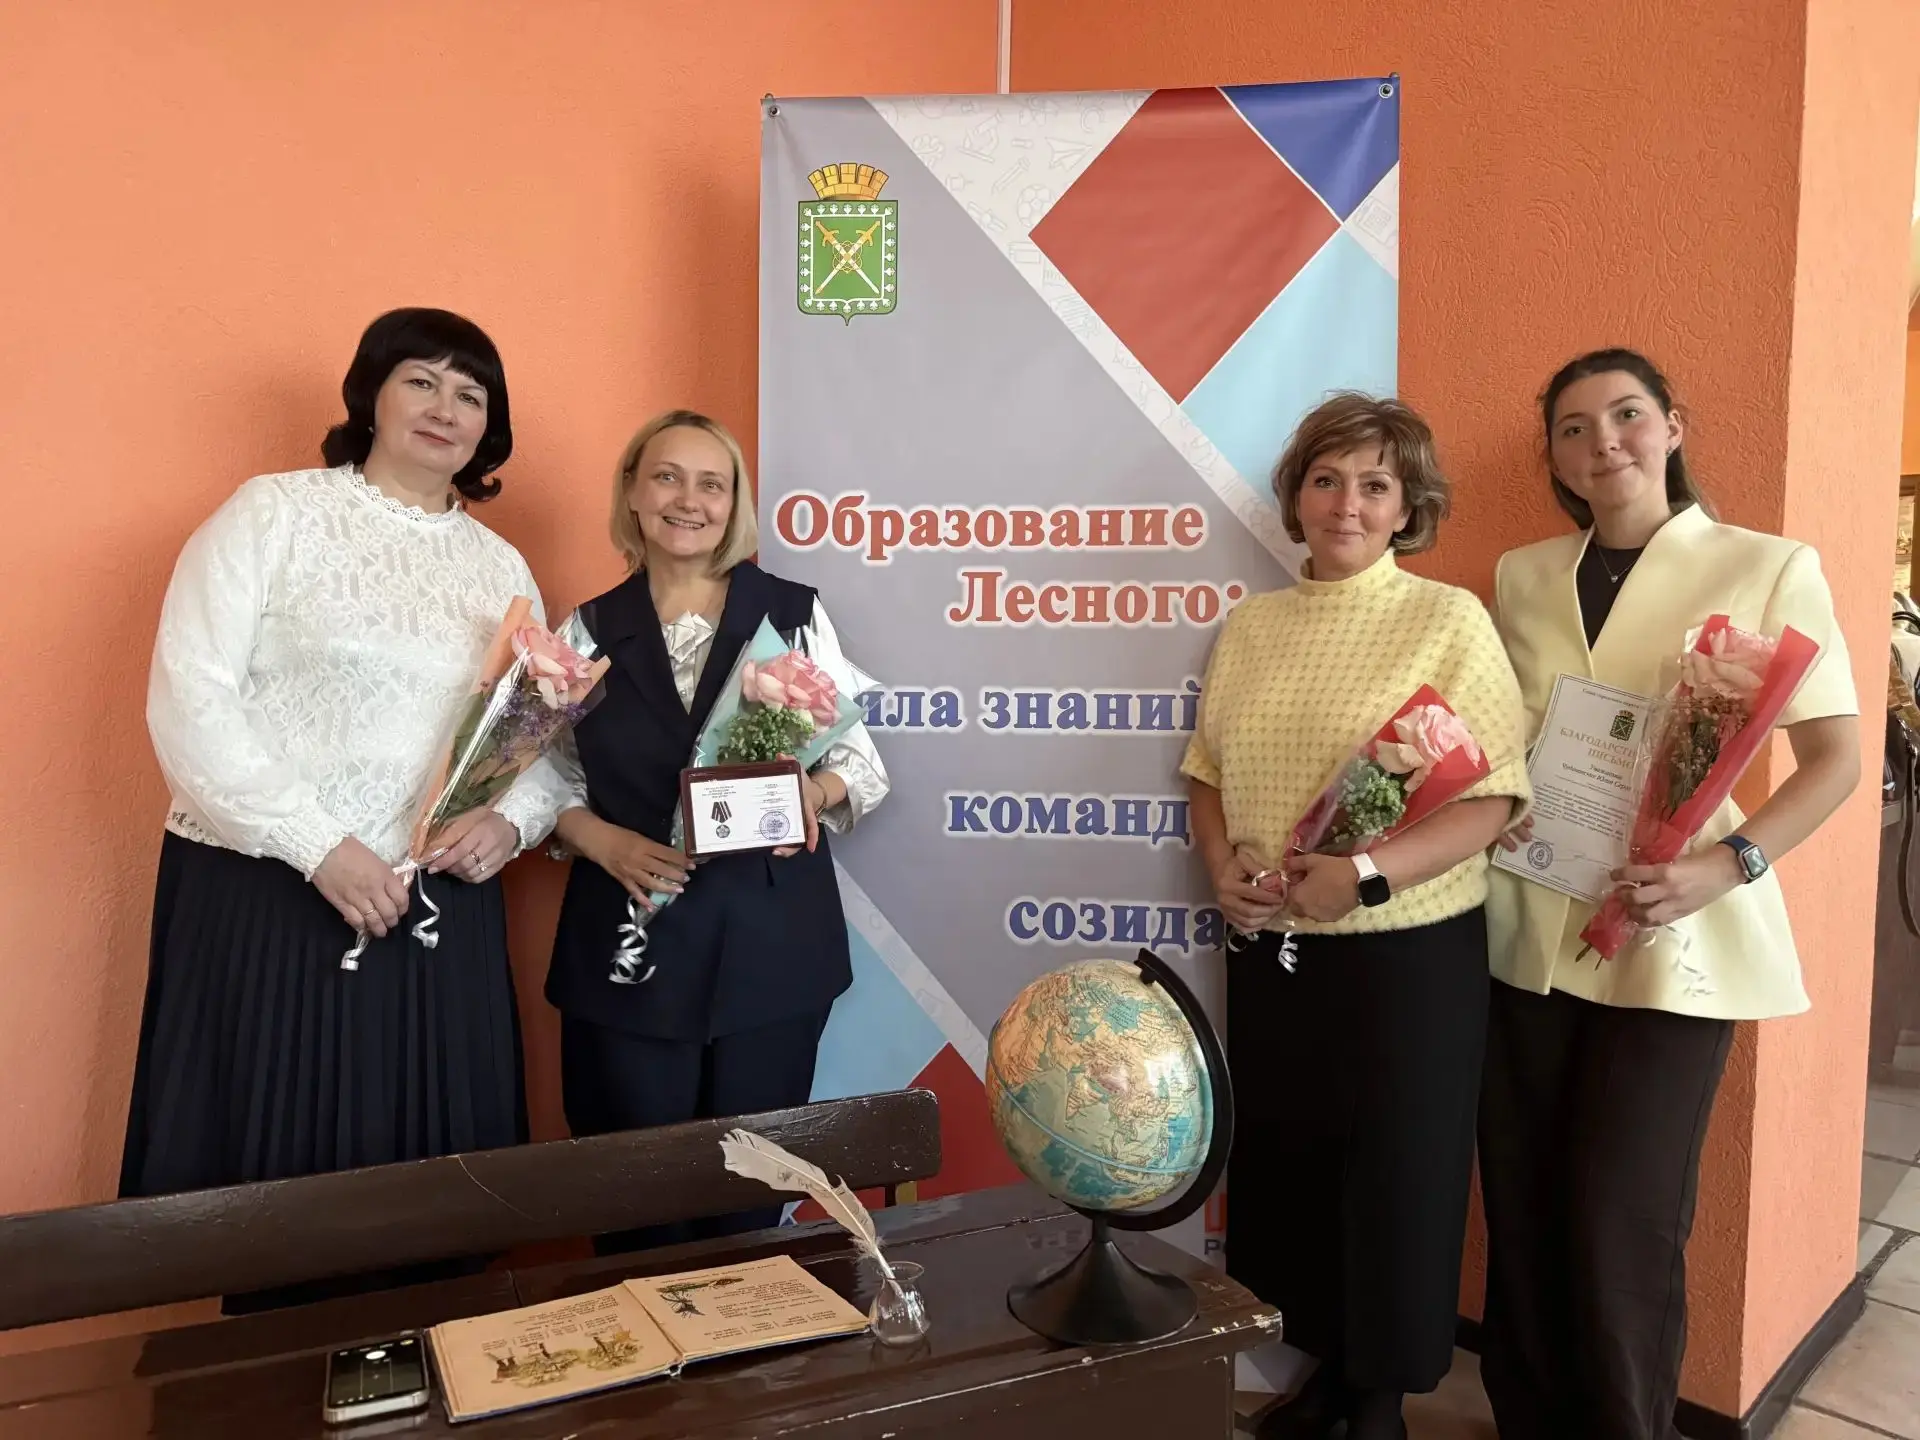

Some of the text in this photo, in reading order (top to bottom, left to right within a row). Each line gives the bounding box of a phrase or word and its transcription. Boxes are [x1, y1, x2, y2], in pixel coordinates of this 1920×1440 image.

[776, 495, 1204, 561] Образование
[854, 690, 963, 728] ила
[1560, 727, 1637, 758] БЛАГОДАРСТВ
[948, 794, 1190, 847] команд
[1008, 901, 1226, 953] созида
